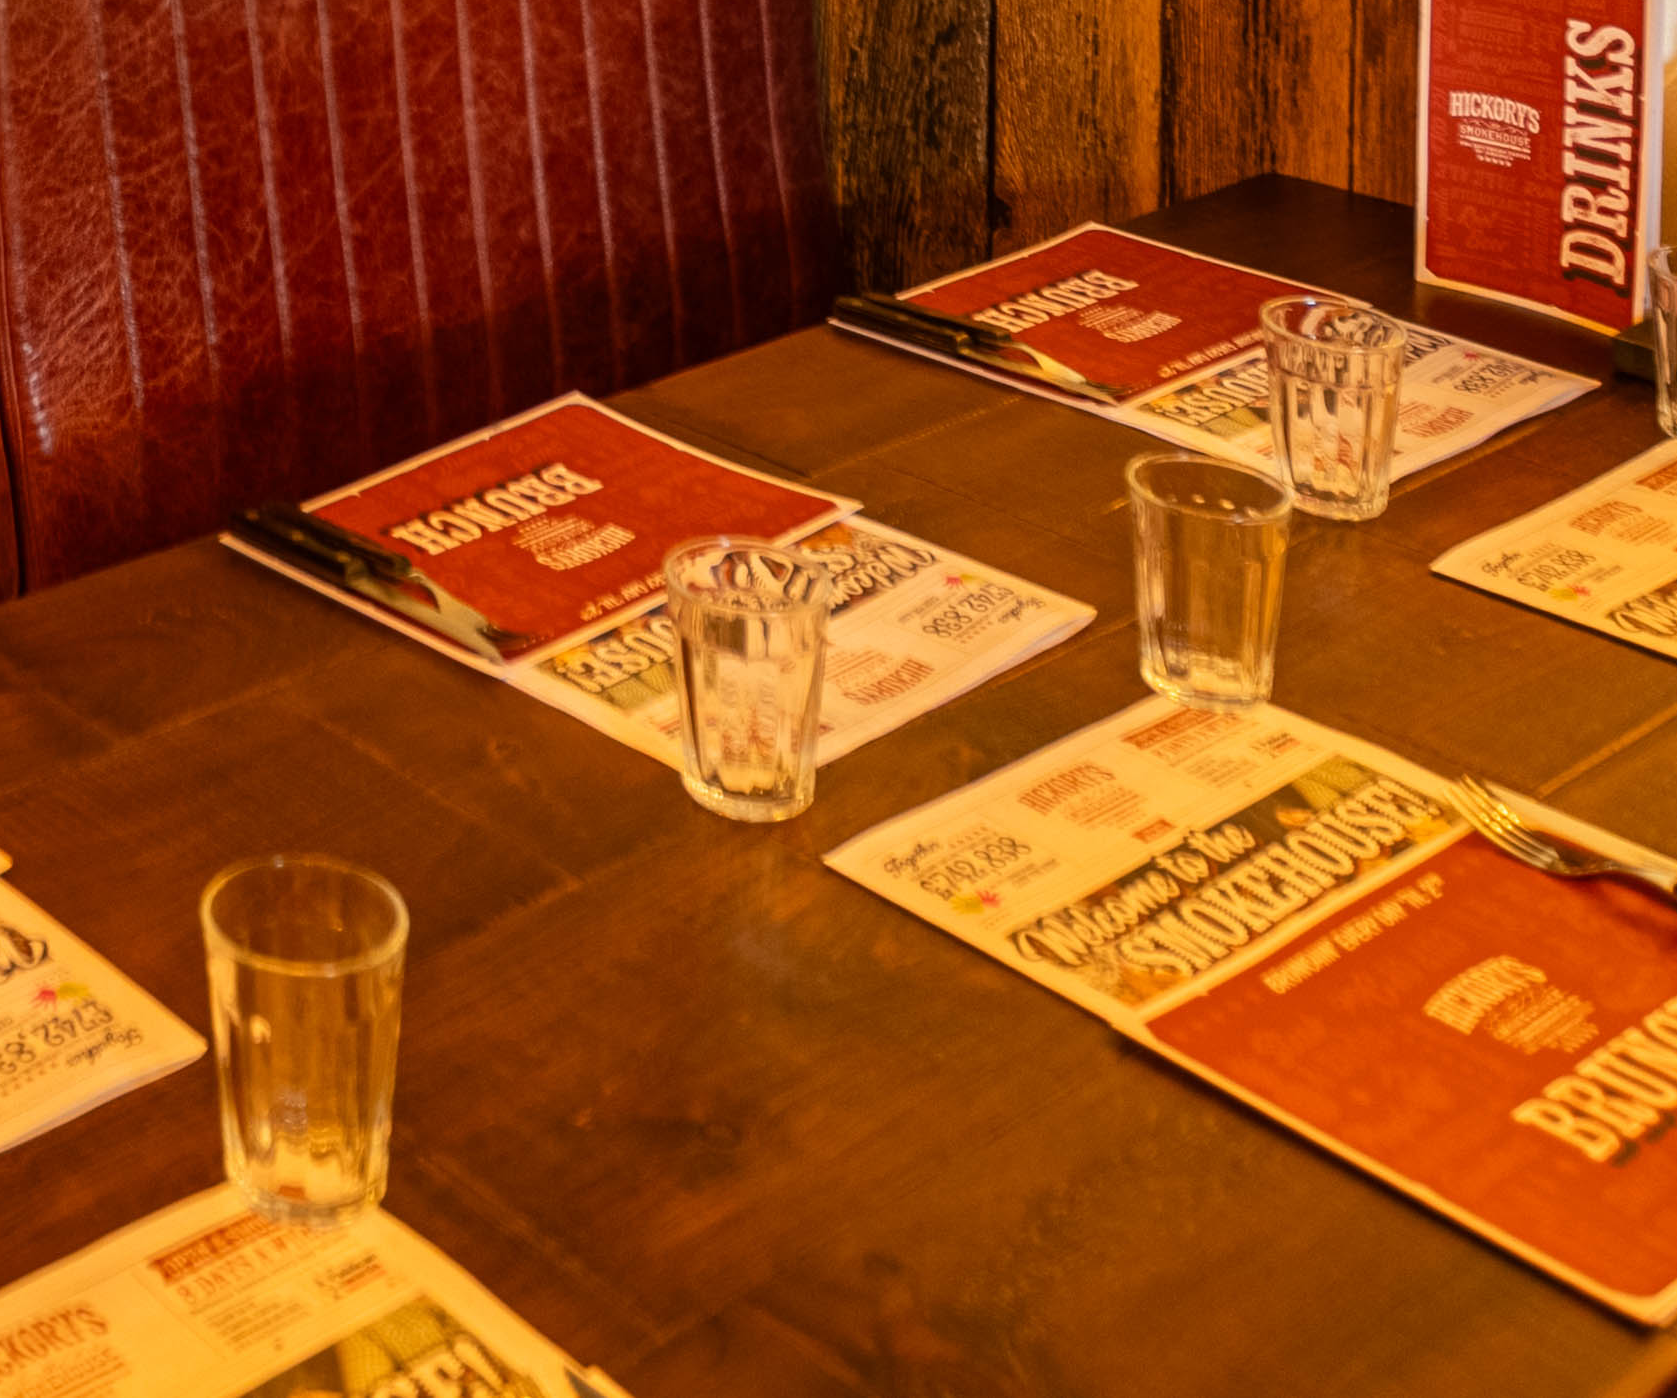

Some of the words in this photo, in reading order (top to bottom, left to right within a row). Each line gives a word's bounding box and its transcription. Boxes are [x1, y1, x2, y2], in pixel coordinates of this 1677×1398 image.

[1448, 90, 1541, 134] HICKORY'S
[1459, 124, 1531, 148] SMOKEHOUSE
[1560, 18, 1635, 286] DRINKS
[973, 269, 1139, 334] BRUNCH
[392, 463, 604, 555] BRUNCH
[843, 656, 935, 706] HICKORY'S
[1009, 867, 1182, 970] Welcome
[1152, 845, 1210, 885] to
[1185, 822, 1257, 865] the
[1117, 777, 1441, 977] SMOKEHOUSE!
